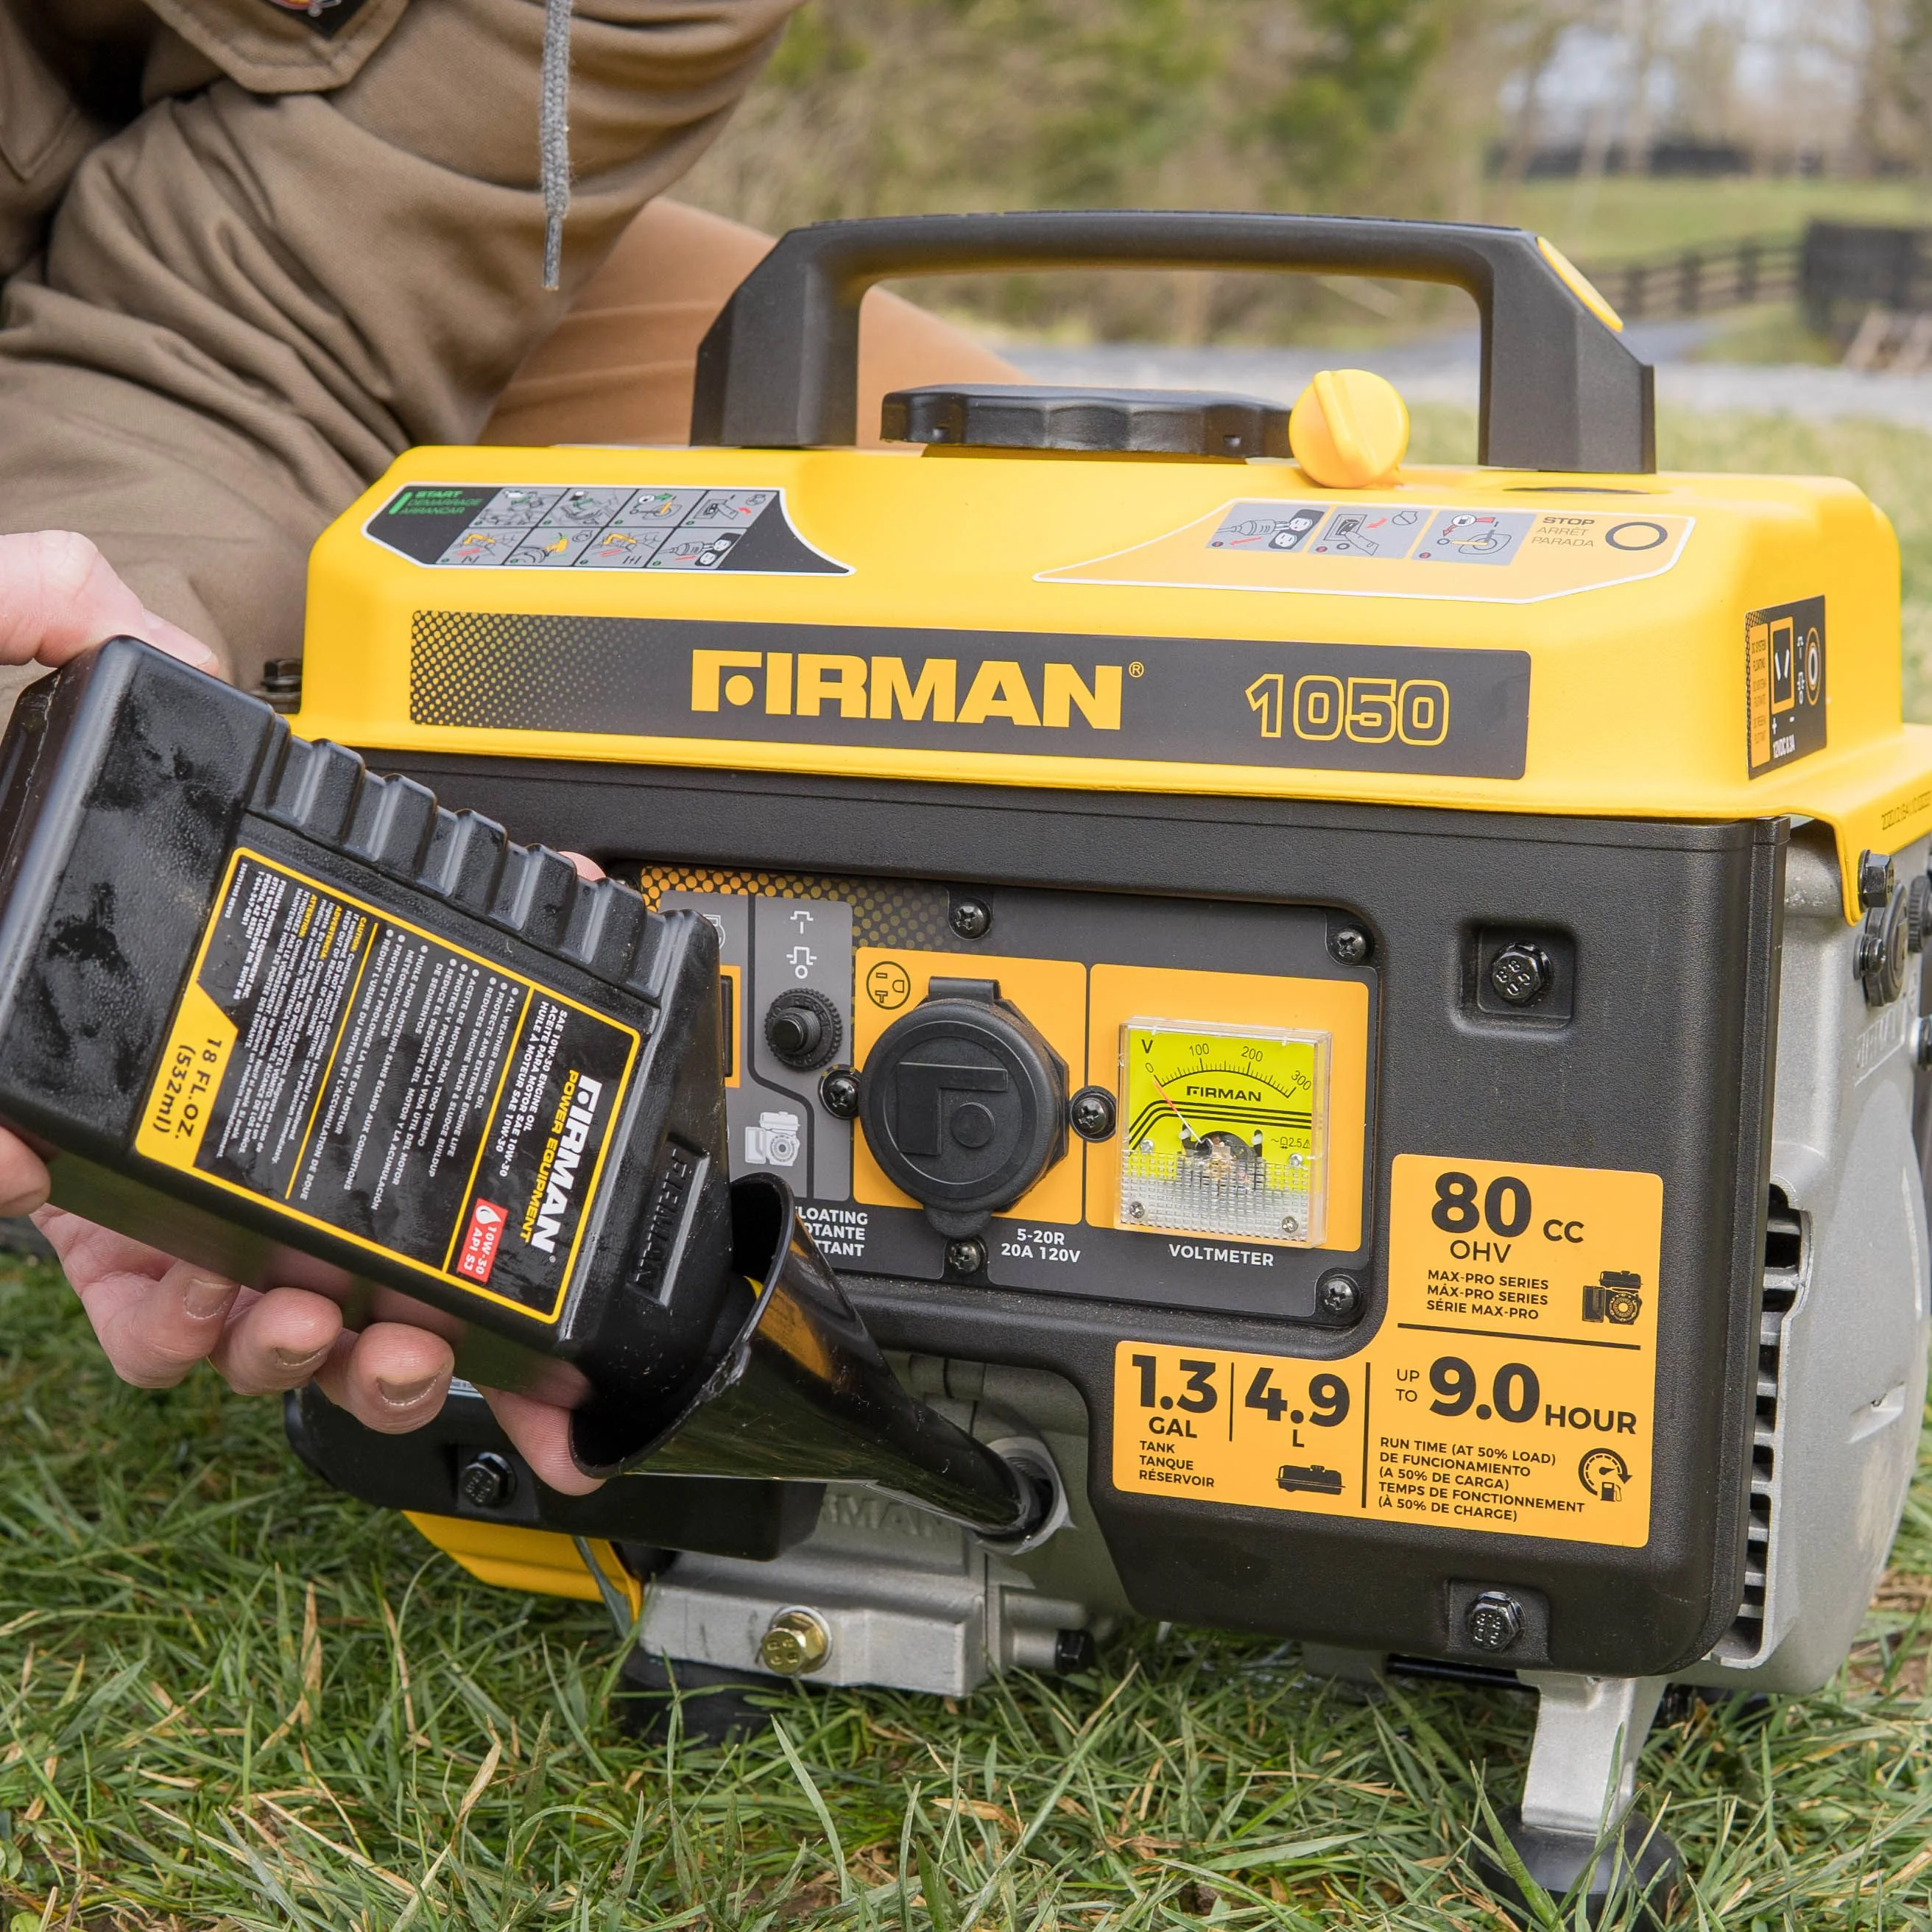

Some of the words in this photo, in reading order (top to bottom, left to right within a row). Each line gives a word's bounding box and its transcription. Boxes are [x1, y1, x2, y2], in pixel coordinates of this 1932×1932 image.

[415, 490, 464, 498] START
[1536, 526, 1589, 537] ARRÊT
[1543, 516, 1596, 526] STOP
[1531, 536, 1594, 547] PARADA
[691, 649, 1121, 730] FIRMAN
[1246, 674, 1450, 747] 1050
[410, 953, 426, 982] HUILE
[433, 962, 444, 976] DE
[378, 986, 389, 999] ET
[402, 982, 416, 1008] POUR
[436, 967, 454, 1004] REDUCE
[445, 973, 465, 1015] PROTEGE
[460, 977, 476, 1011] ACEITE
[415, 976, 439, 1034] SEDIMENTOS
[431, 1004, 442, 1016] EL
[474, 986, 494, 1028] REDUCES
[484, 991, 505, 1037] PROTECTS
[504, 995, 515, 1012] ALL
[356, 1011, 367, 1026] DU
[362, 999, 384, 1048] PROLONGE
[455, 1011, 466, 1025] DE
[532, 1001, 549, 1033] HUILE
[540, 1004, 558, 1043] ACEITE
[554, 1009, 568, 1032] SAE
[387, 1009, 408, 1053] MOTEURS
[417, 1017, 438, 1065] DESGASTE
[445, 1025, 462, 1058] MOTOR
[490, 1015, 510, 1059] WEATHER
[529, 1032, 540, 1042] À
[202, 1038, 222, 1063] 18
[343, 1026, 362, 1065] MOTEUR
[357, 1048, 368, 1062] LA
[427, 1023, 449, 1072] PROLONGA
[463, 1028, 480, 1063] ENGINE
[478, 1037, 490, 1058] AND
[530, 1043, 546, 1073] PARA
[542, 1033, 561, 1072] 10W-30
[1141, 1039, 1154, 1054] V
[1188, 1043, 1210, 1057] 100
[1241, 1046, 1263, 1062] 200
[339, 1065, 349, 1079] ET
[352, 1064, 364, 1080] VIE
[379, 1053, 393, 1079] SANS
[410, 1065, 422, 1083] DEL
[437, 1058, 451, 1083] PARA
[454, 1064, 469, 1092] WEAR
[479, 1059, 496, 1094] ENGINE
[515, 1043, 535, 1088] MOTEUR
[1145, 1062, 1154, 1073] 0
[152, 1044, 196, 1133] (532ml)
[348, 1080, 358, 1095] DU
[423, 1073, 433, 1085] LA
[464, 1059, 483, 1101] EXTENDS
[1291, 1070, 1312, 1090] 300
[174, 1070, 211, 1139] FL.OZ.
[399, 1087, 415, 1121] MOTOR
[415, 1088, 429, 1110] VIDA
[429, 1086, 443, 1111] TODO
[473, 1094, 484, 1109] OIL
[507, 1089, 521, 1112] SAE
[518, 1074, 537, 1113] MOTOR
[529, 1073, 548, 1113] ENGINE
[551, 1069, 579, 1134] POWER
[1186, 1085, 1261, 1102] FIRMAN
[334, 1095, 353, 1135] MOTEUR
[362, 1112, 373, 1133] AUX
[440, 1100, 457, 1137] SLUDGE
[453, 1101, 470, 1136] ENGINE
[511, 1113, 525, 1136] SAE
[523, 1114, 535, 1132] OIL
[391, 1129, 402, 1142] LA
[402, 1132, 414, 1150] DEL
[417, 1113, 434, 1146] TIEMPO
[495, 1113, 514, 1152] 10W-30
[428, 1137, 445, 1177] BUILDUP
[446, 1137, 459, 1157] LIFE
[498, 1138, 518, 1177] 10W-30
[309, 1158, 319, 1173] DE
[343, 1133, 367, 1191] CONDITIONS
[391, 1152, 408, 1185] MOTOR
[530, 1074, 602, 1253] FIRMAN
[519, 1137, 559, 1243] EQUIPMENT
[795, 1206, 868, 1225] LOATING
[1431, 1171, 1532, 1238] 80
[468, 1227, 483, 1252] API
[803, 1223, 866, 1241] OTANTE
[1017, 1228, 1065, 1246] 5-20R
[463, 1253, 476, 1271] SJ
[475, 1226, 497, 1275] 10W-30
[1001, 1243, 1034, 1258] 20A
[1039, 1247, 1081, 1263] 120V
[1168, 1244, 1274, 1267] VOLTMETER
[1450, 1239, 1512, 1263] OHV
[1428, 1269, 1495, 1286] MAX-PRO
[1499, 1276, 1549, 1290] SERIES
[1427, 1283, 1494, 1300] MÁX-PRO
[1498, 1291, 1548, 1305] SERIES
[1426, 1298, 1467, 1314] SÉRIE
[1472, 1304, 1539, 1320] MAX-PRO
[1132, 1353, 1218, 1414] 1.3
[1397, 1369, 1420, 1382] UP
[1245, 1367, 1350, 1428] 4.9
[1395, 1389, 1417, 1403] TO
[1429, 1355, 1540, 1422] 9.0
[1545, 1404, 1637, 1435] HOUR
[1149, 1416, 1198, 1439] GAL
[1292, 1429, 1305, 1448] L
[1140, 1440, 1175, 1453] TANK
[1380, 1436, 1410, 1450] RUN
[1414, 1439, 1447, 1453] TIME
[1452, 1443, 1473, 1457] (AT
[1477, 1446, 1509, 1460] 50%
[1512, 1450, 1556, 1466] LOAD)
[1139, 1455, 1194, 1470] TANQUE
[1380, 1452, 1399, 1464] DE
[1403, 1454, 1531, 1477] FUNCIONAMIENTO
[1139, 1468, 1215, 1487] RÉSERVOIR
[1379, 1466, 1394, 1479] (A
[1397, 1468, 1428, 1481] 50%
[1431, 1471, 1451, 1484] DE
[1454, 1474, 1509, 1491] CARGA)
[1378, 1494, 1393, 1508] (À
[1397, 1498, 1427, 1512] 50%
[1431, 1501, 1450, 1514] DE
[1453, 1503, 1517, 1522] CHARGE)
[1379, 1481, 1425, 1496] TEMPS
[1429, 1486, 1448, 1499] DE
[1452, 1488, 1585, 1513] FONCTIONNEMENT
